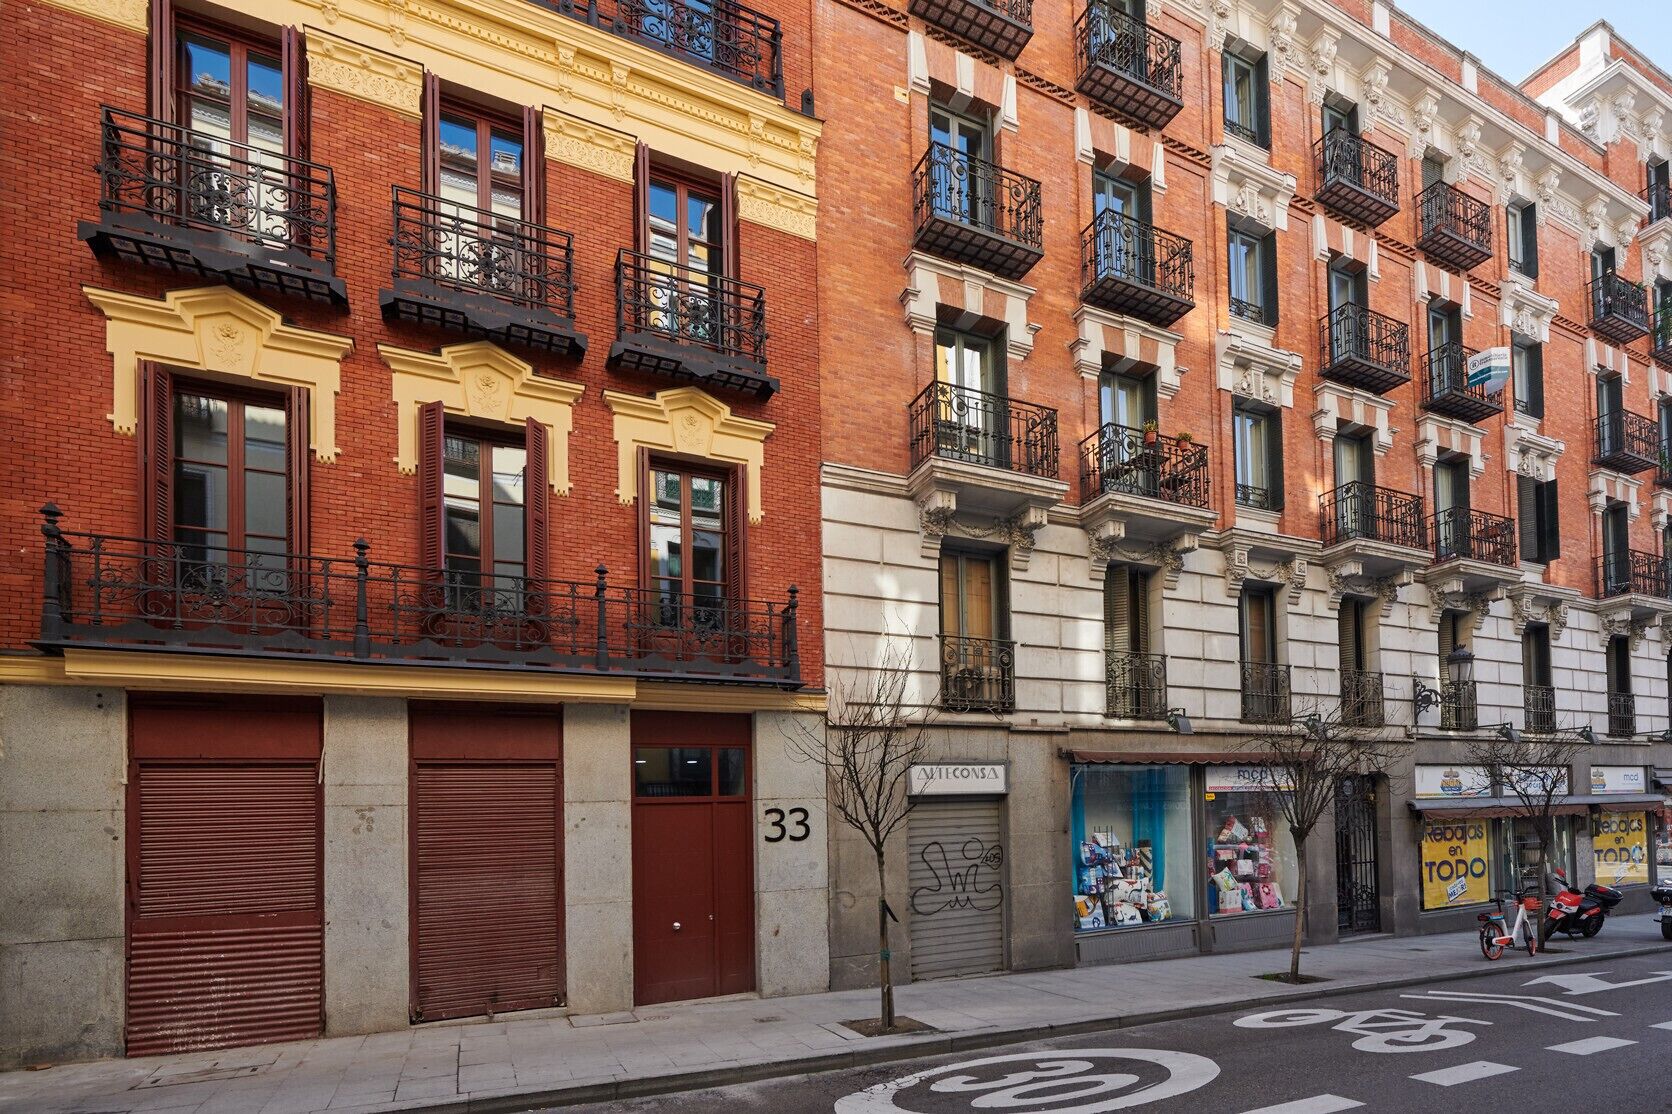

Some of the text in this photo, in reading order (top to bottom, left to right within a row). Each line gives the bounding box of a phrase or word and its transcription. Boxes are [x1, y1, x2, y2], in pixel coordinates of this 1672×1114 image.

[764, 807, 811, 843] 33
[1448, 845, 1463, 856] en
[1614, 836, 1625, 845] en
[1424, 857, 1487, 883] TODO
[929, 1060, 1140, 1108] 30
